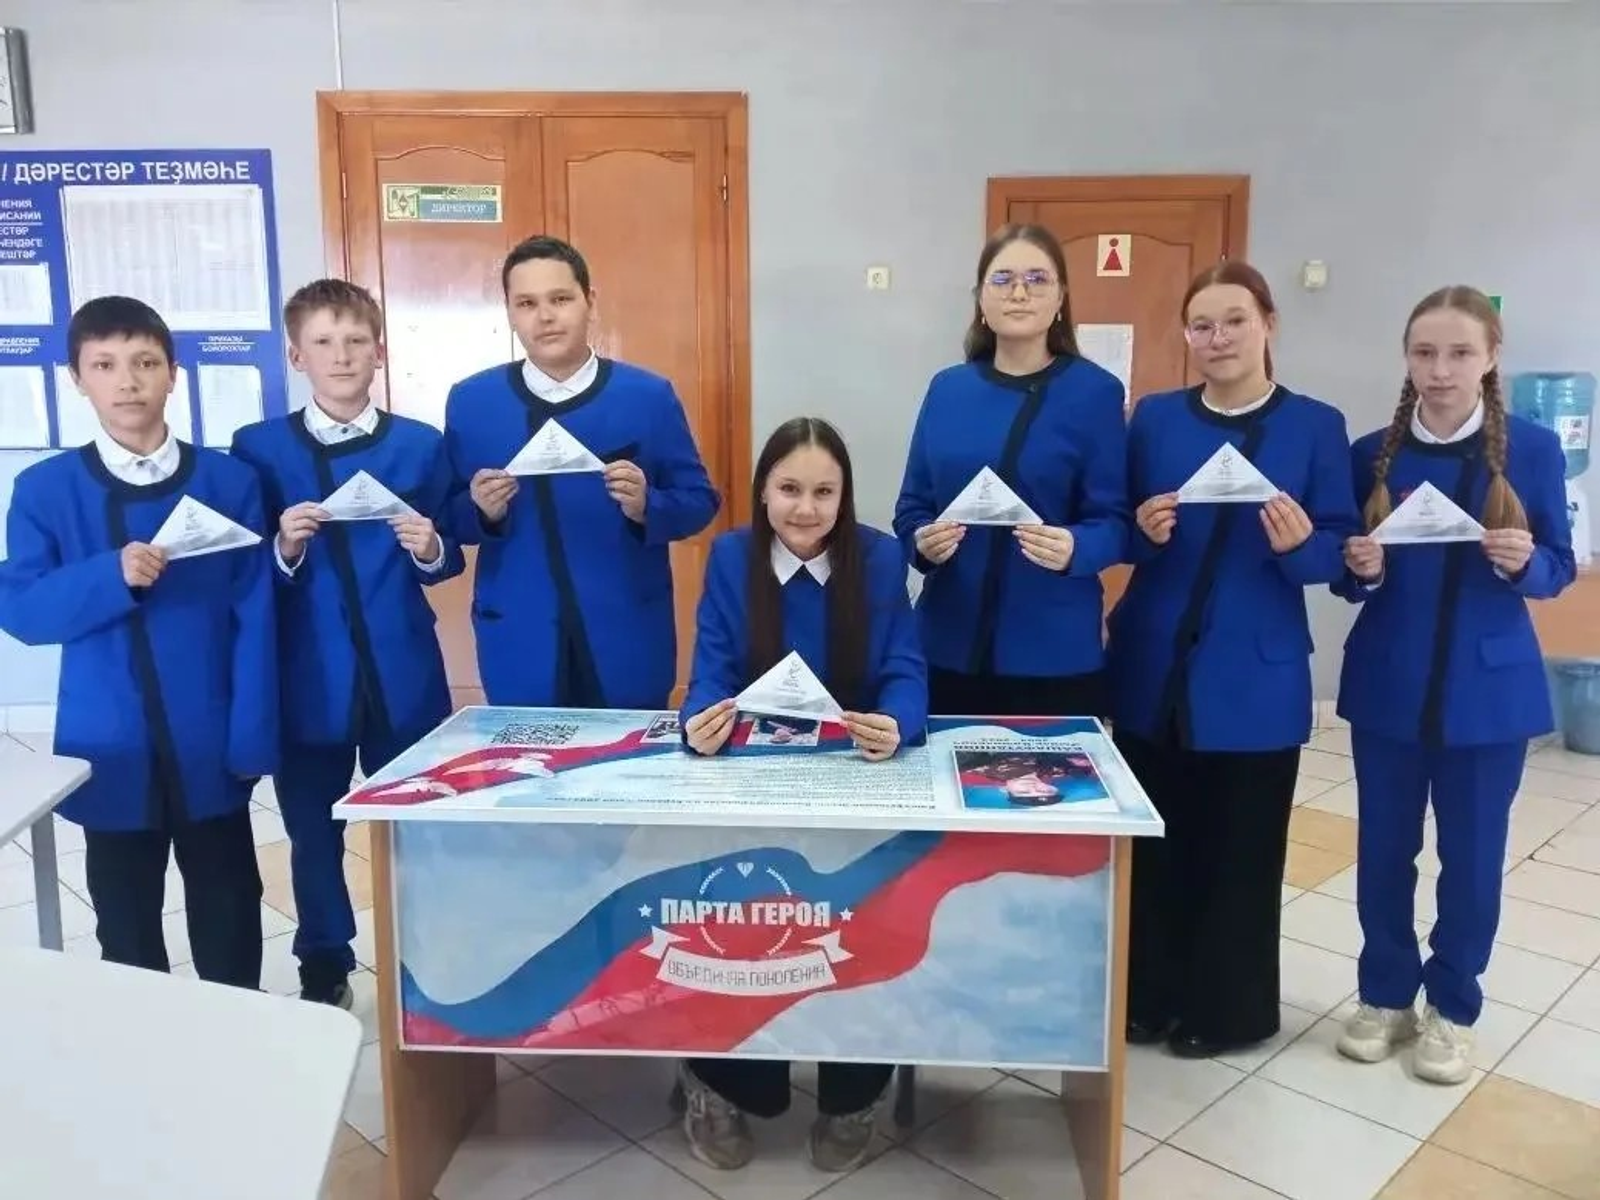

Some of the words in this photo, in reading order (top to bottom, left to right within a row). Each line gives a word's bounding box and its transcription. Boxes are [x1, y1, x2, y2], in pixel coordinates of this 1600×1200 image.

[14, 162, 135, 184] ДӘРЕСТӘР
[431, 203, 487, 213] ДИРЕКТОР
[660, 898, 745, 924] ПАРТА
[751, 901, 831, 927] ГЕРОЯ
[668, 960, 746, 987] ОБЪЕДИНЯЯ
[749, 963, 826, 987] ПОКОЛЕНИЯ
